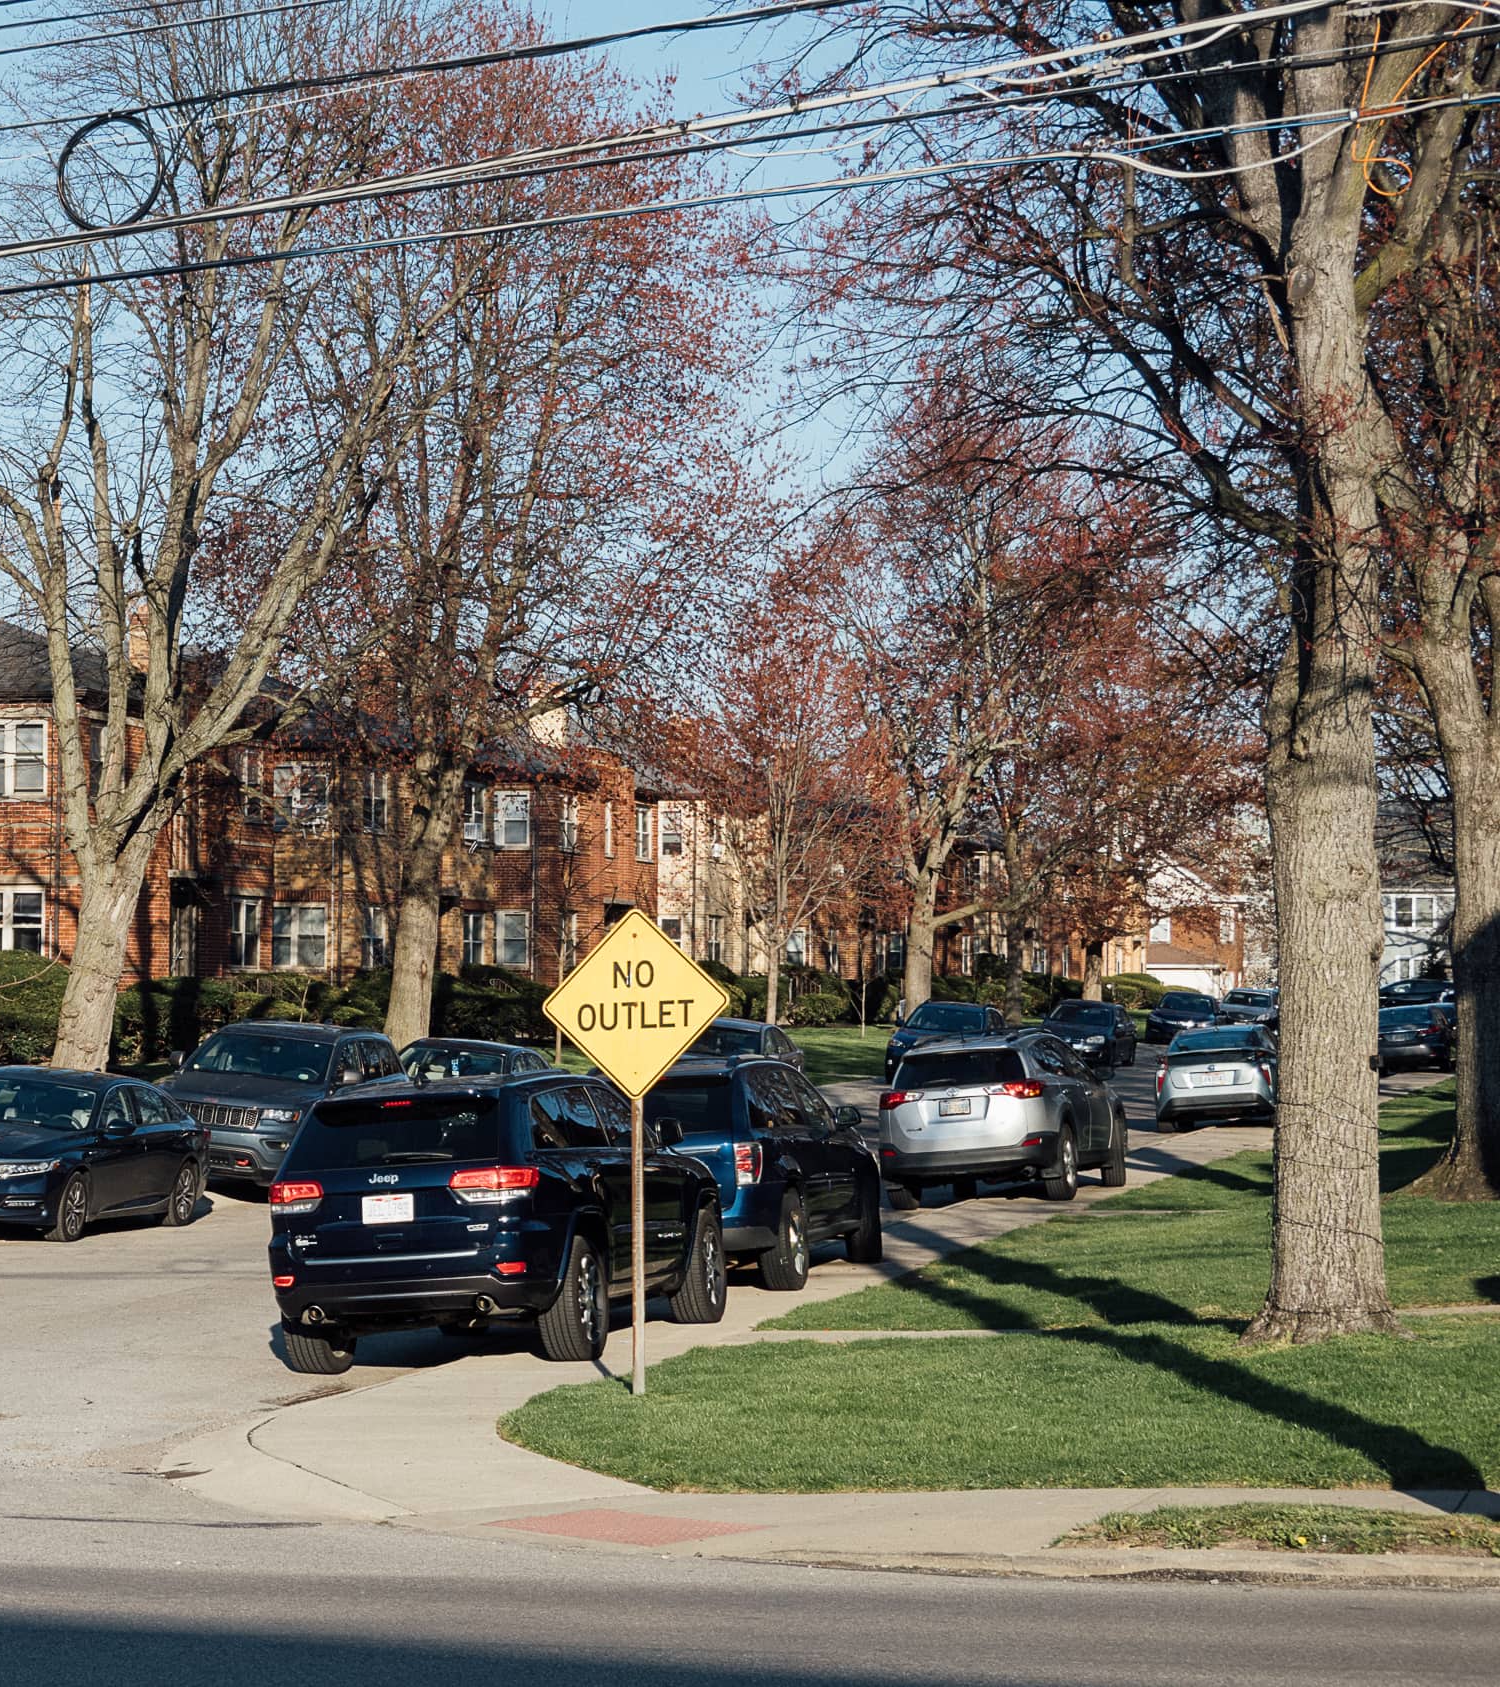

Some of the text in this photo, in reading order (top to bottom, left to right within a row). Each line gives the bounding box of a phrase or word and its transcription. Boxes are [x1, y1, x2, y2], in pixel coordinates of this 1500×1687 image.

[613, 960, 654, 989] NO
[578, 999, 694, 1031] OUTLET
[368, 1173, 400, 1185] Jeep
